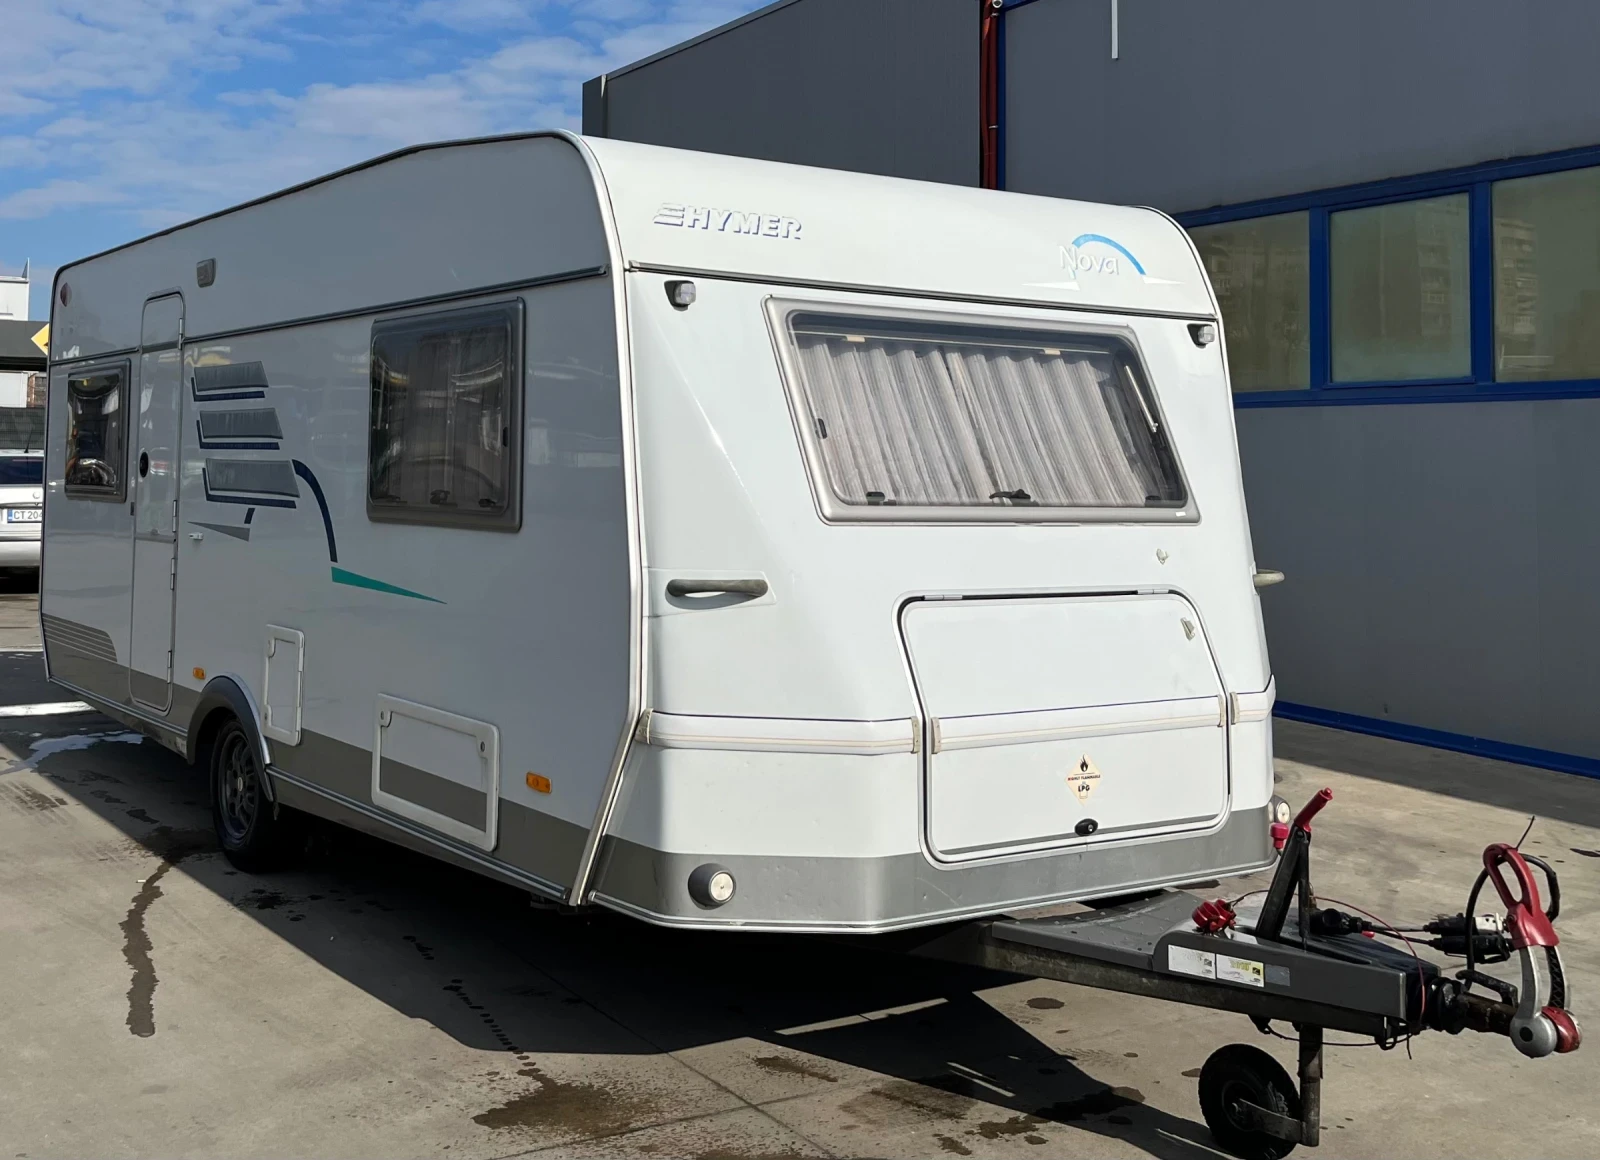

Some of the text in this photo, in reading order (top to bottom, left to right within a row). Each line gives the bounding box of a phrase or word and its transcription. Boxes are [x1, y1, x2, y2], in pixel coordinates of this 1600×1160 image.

[687, 205, 802, 240] HYMER
[1058, 244, 1120, 276] Nova
[13, 510, 26, 520] CT
[1077, 784, 1090, 792] LPG
